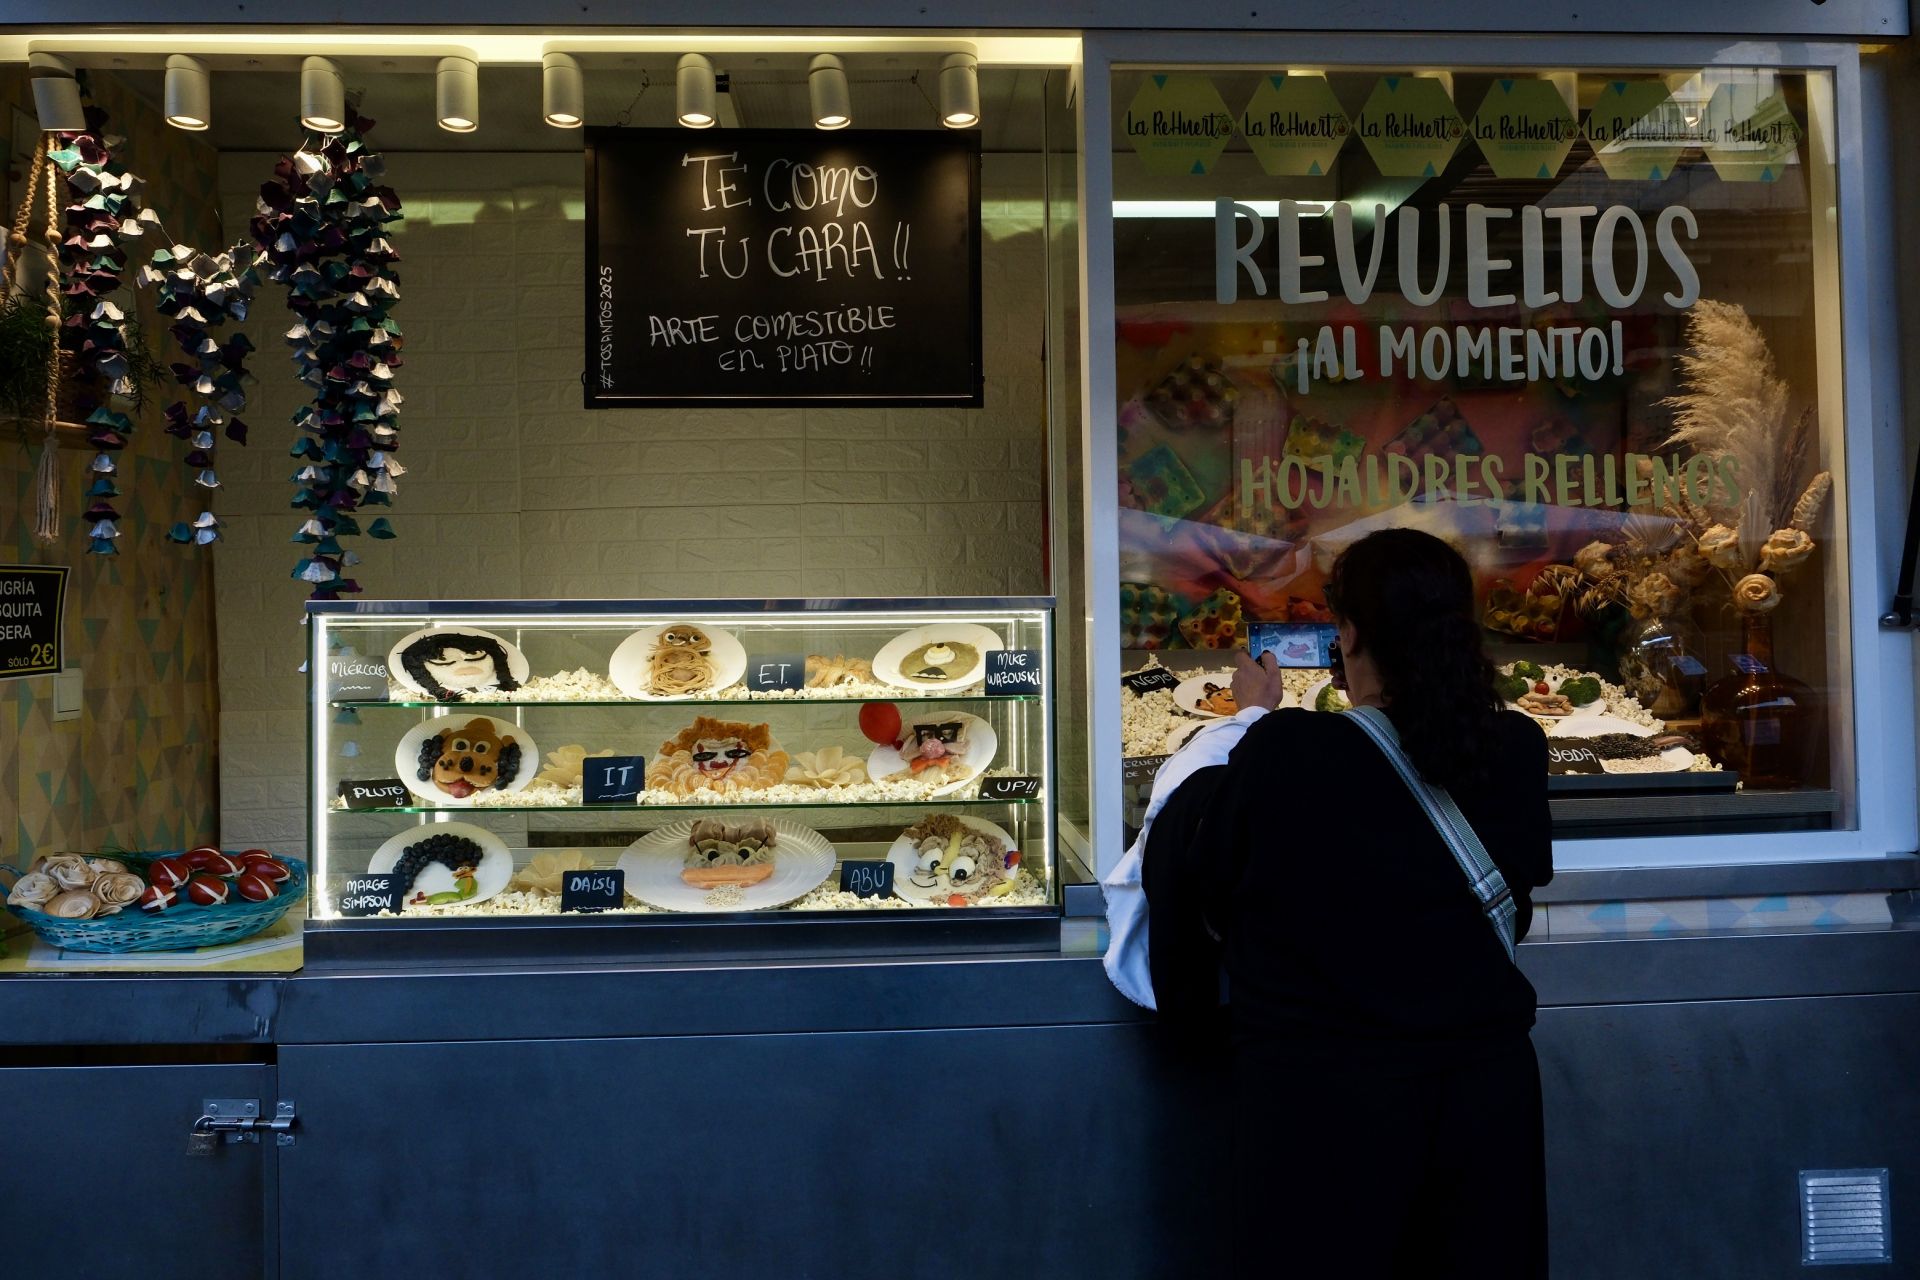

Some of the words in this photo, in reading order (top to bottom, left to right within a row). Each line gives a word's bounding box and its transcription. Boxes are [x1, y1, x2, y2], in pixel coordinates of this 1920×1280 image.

[1127, 110, 1148, 136] La
[1245, 111, 1265, 137] La
[1360, 112, 1381, 138] La
[1475, 114, 1496, 140] La
[1588, 116, 1608, 141] La
[682, 151, 752, 212] TE
[686, 225, 749, 279] TU
[1215, 196, 1701, 309] REVUELTOS
[599, 265, 615, 389] #TOSANTOS2025
[649, 314, 720, 347] ARTE
[1298, 325, 1364, 395] ¡AL
[1379, 320, 1624, 382] MOMENTO!
[1241, 452, 1504, 512] HOJALDRES
[1524, 452, 1741, 508] RELLENOS
[30, 643, 54, 666] 2€
[1548, 747, 1597, 763] YODA
[603, 765, 634, 787] IT
[996, 780, 1038, 794] UP!!
[1125, 770, 1140, 778] DE
[352, 785, 405, 799] PLUTO
[346, 878, 390, 895] MARGE
[850, 863, 885, 897] ABÚ
